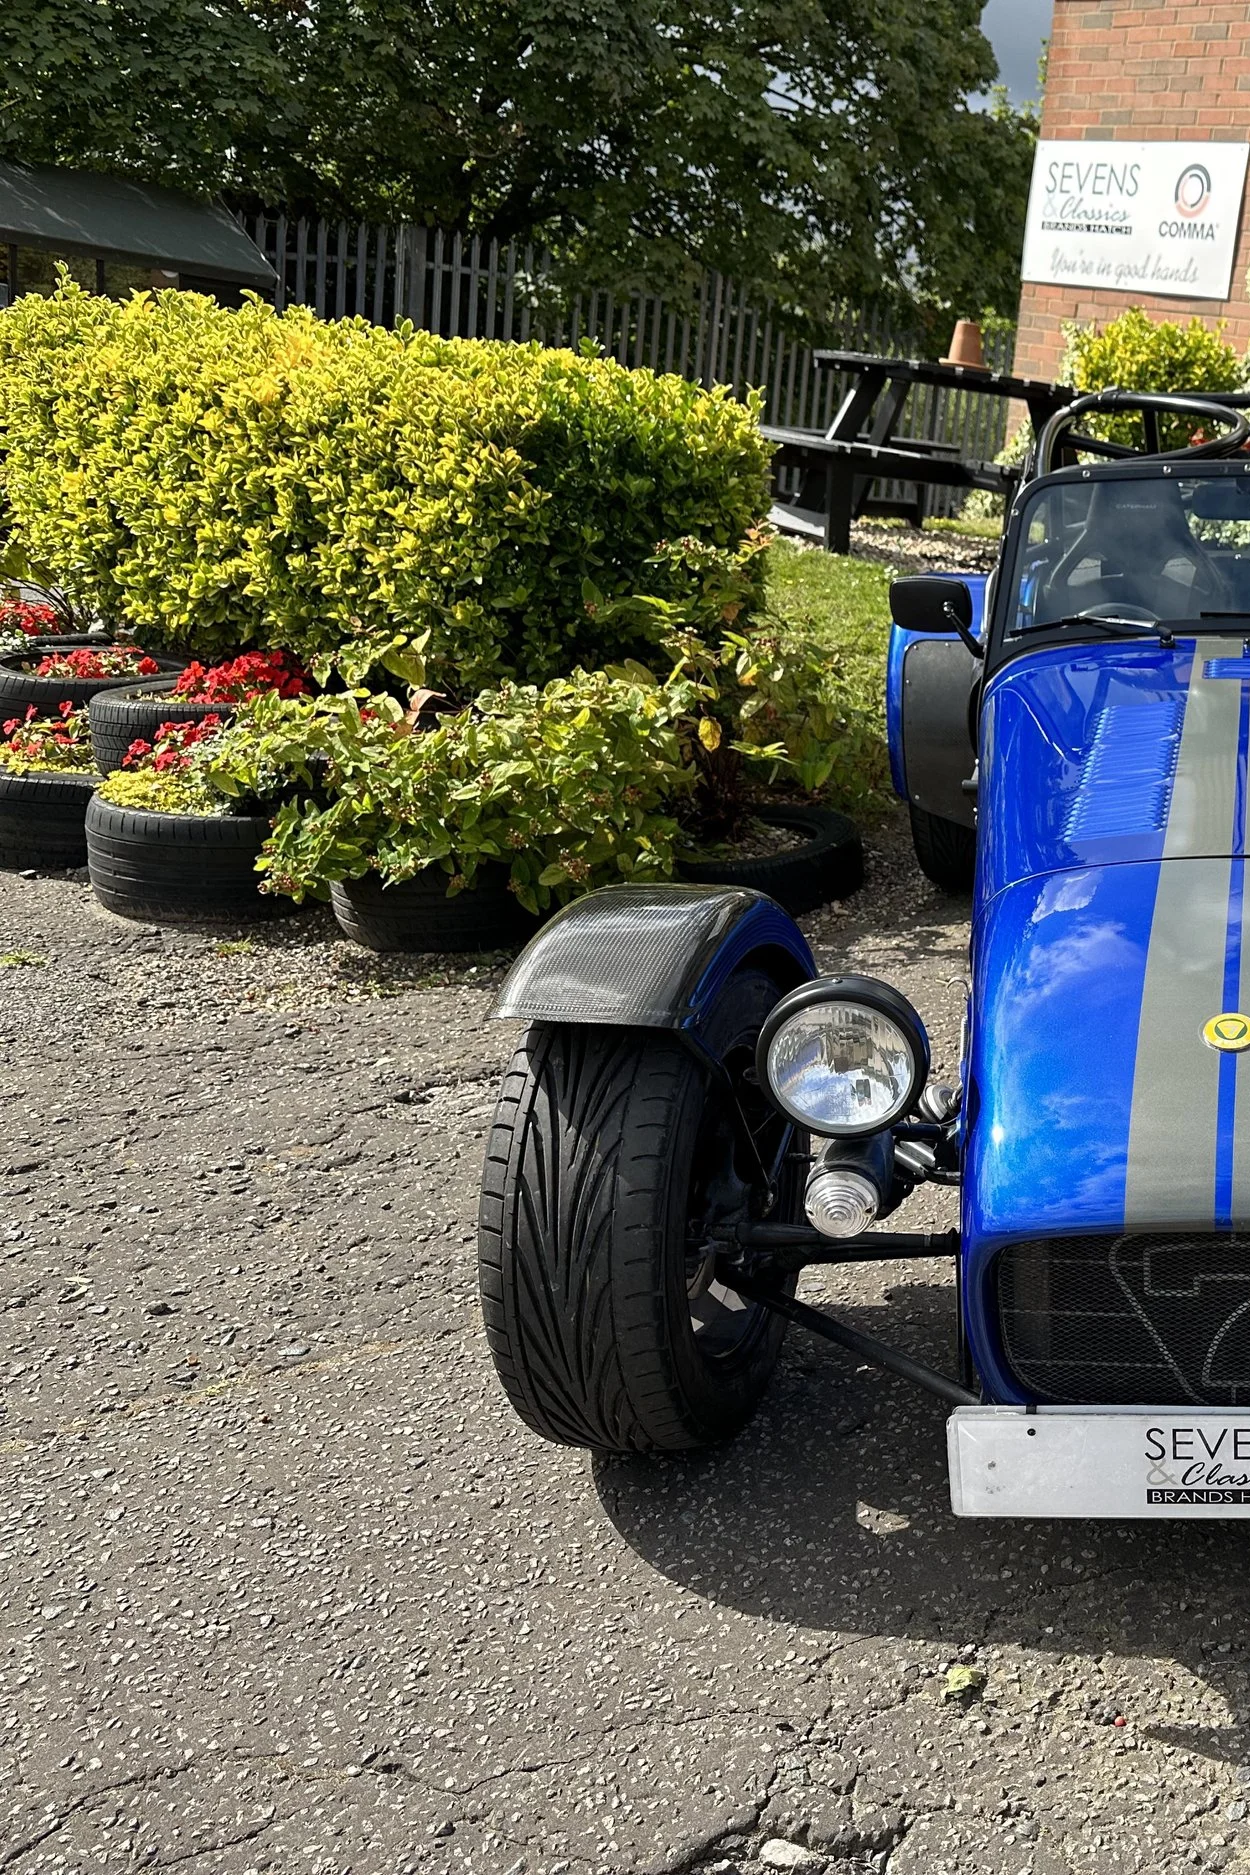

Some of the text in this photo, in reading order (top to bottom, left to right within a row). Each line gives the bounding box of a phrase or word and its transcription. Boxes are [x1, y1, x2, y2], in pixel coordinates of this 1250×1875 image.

[1045, 161, 1141, 197] SEVENS
[1042, 193, 1131, 222] & Classics
[1090, 224, 1130, 235] HATCH
[1158, 221, 1215, 240] COMMA
[1050, 246, 1199, 286] You're in good hands
[1146, 1459, 1178, 1486] &
[1151, 1490, 1234, 1504] BRANDS
